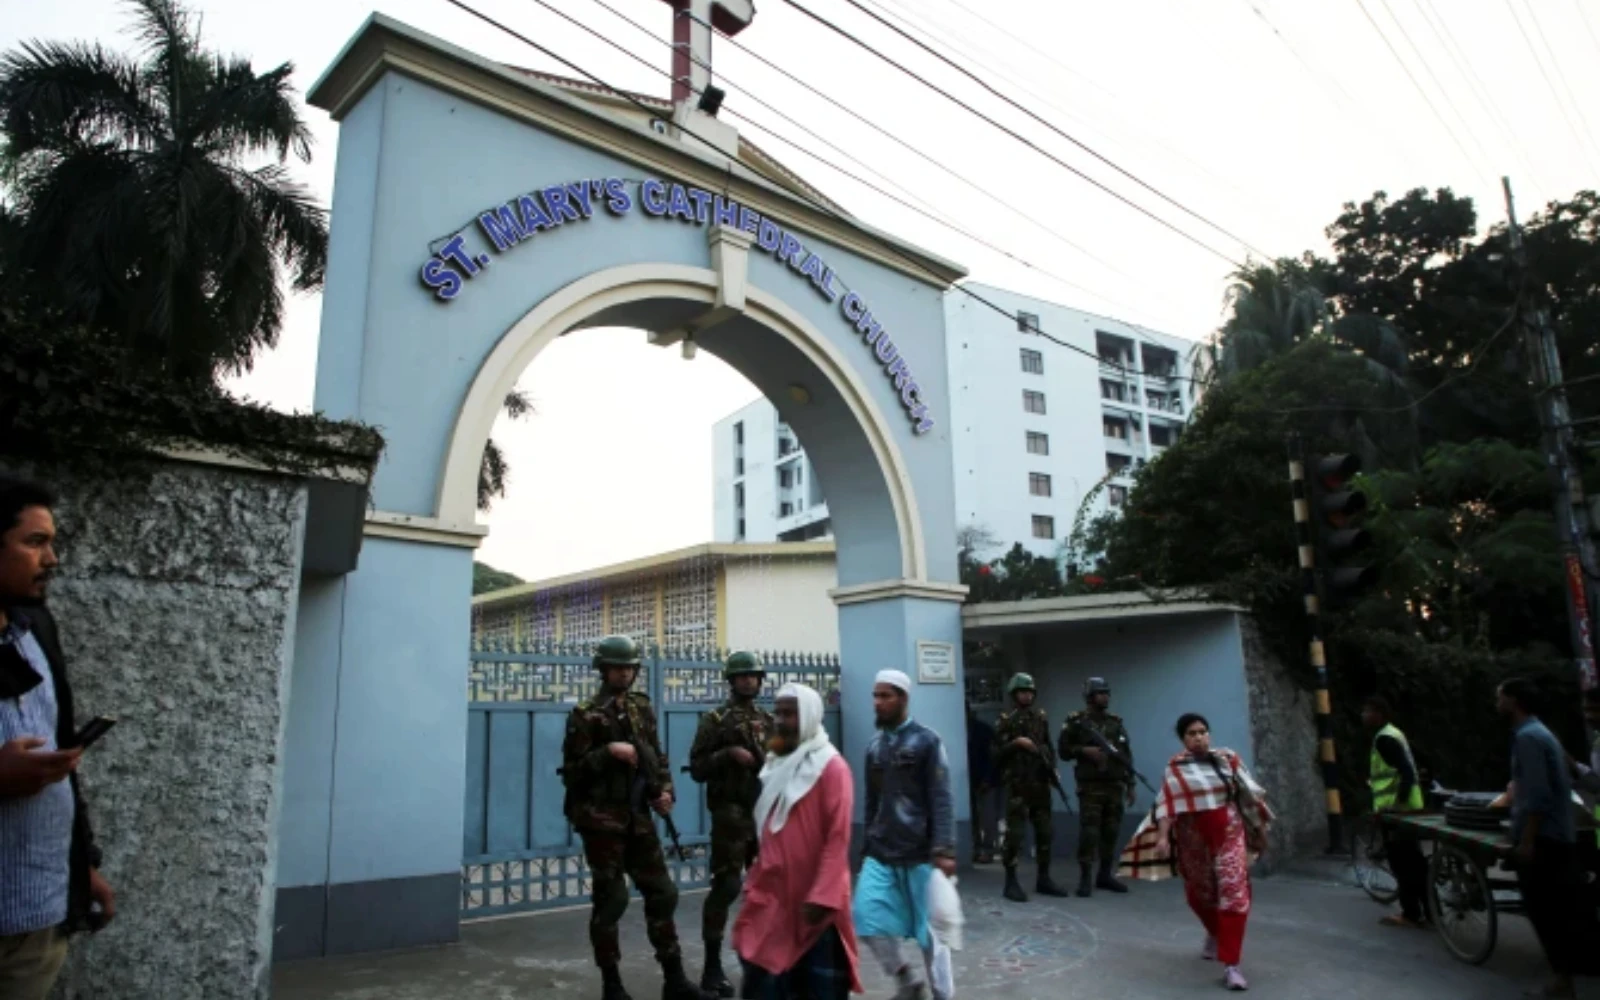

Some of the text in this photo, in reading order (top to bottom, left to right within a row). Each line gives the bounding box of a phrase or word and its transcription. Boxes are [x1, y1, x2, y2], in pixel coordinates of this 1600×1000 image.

[421, 178, 934, 434] ST. MARY'S CATHEDRAL CHURCH
